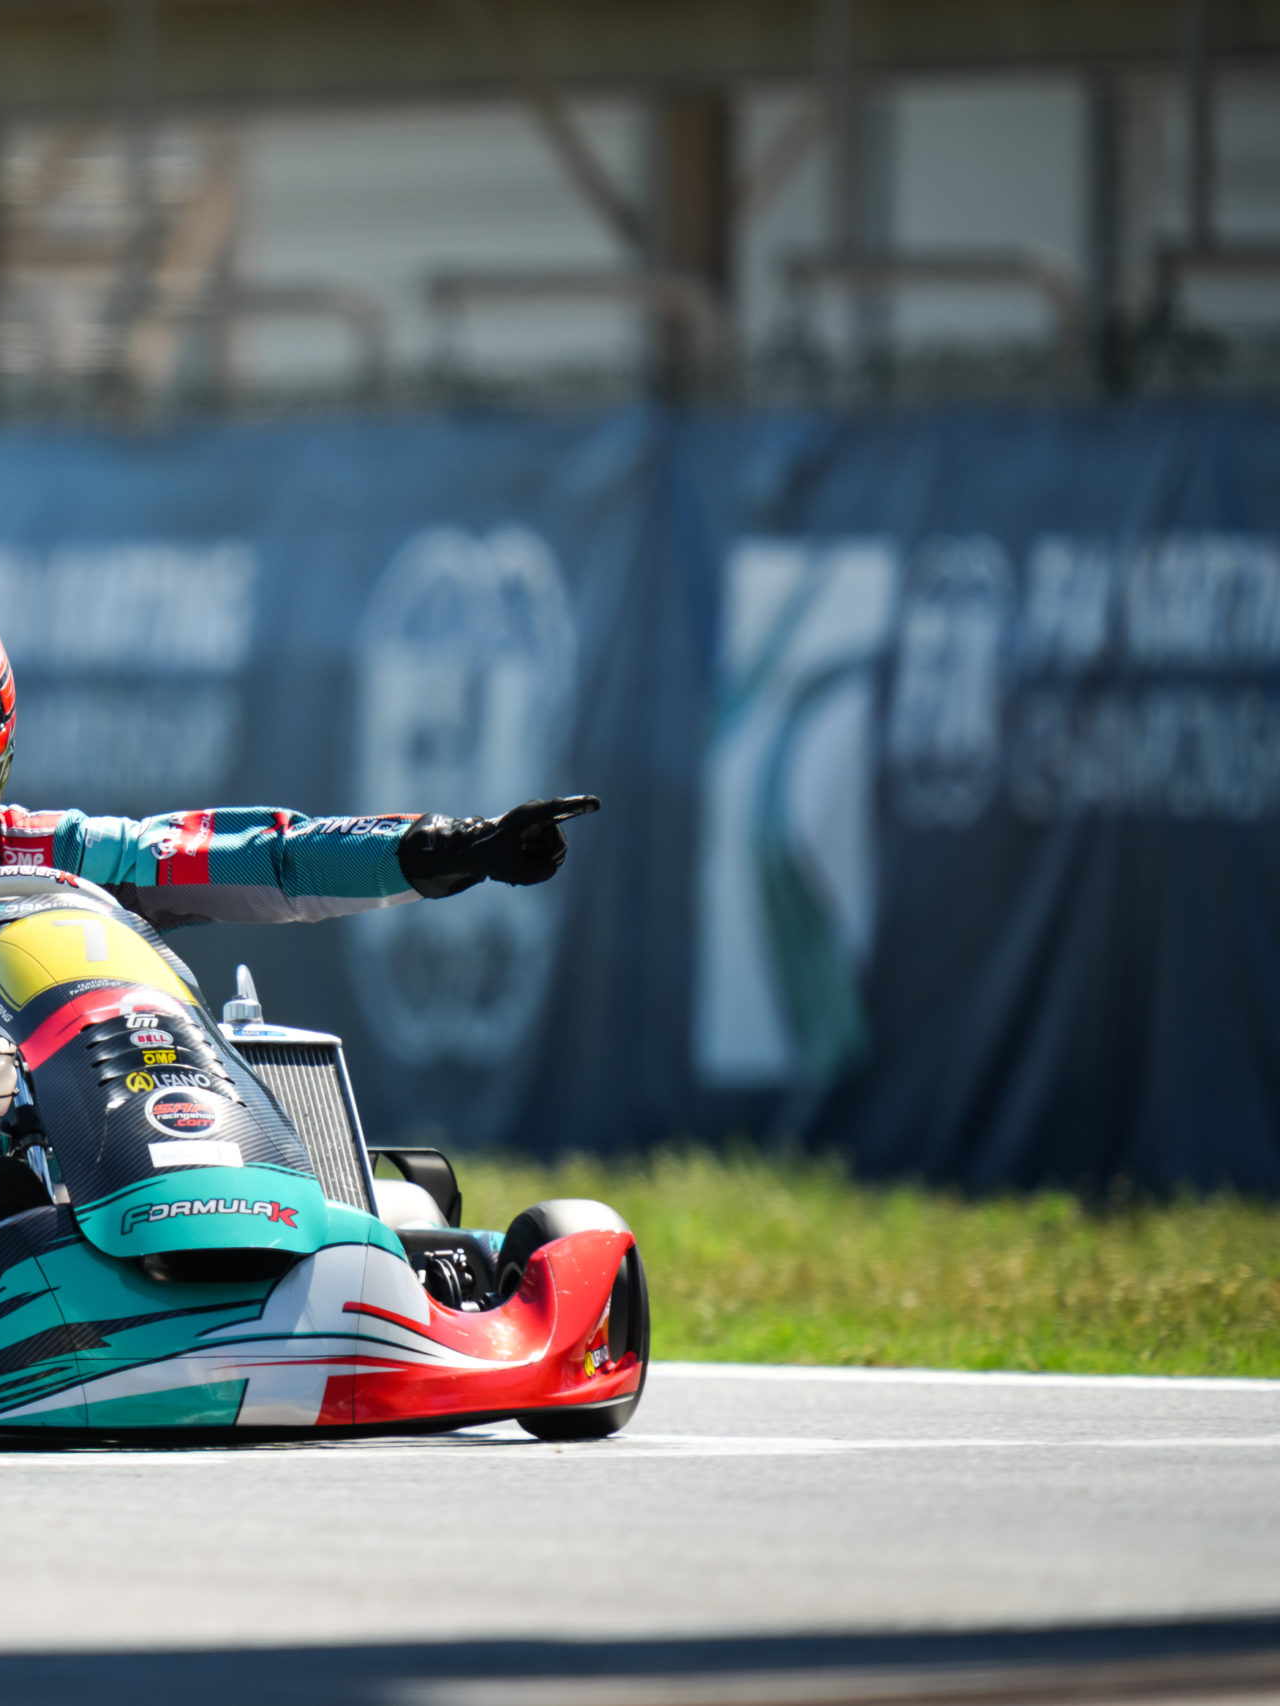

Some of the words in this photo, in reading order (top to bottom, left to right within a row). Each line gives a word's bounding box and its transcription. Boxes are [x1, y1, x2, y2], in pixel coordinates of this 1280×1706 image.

[4, 851, 44, 867] OMP
[52, 920, 109, 962] 7
[137, 1035, 167, 1043] BELL
[144, 1053, 176, 1064] OMP
[126, 1071, 211, 1093] ALFANO
